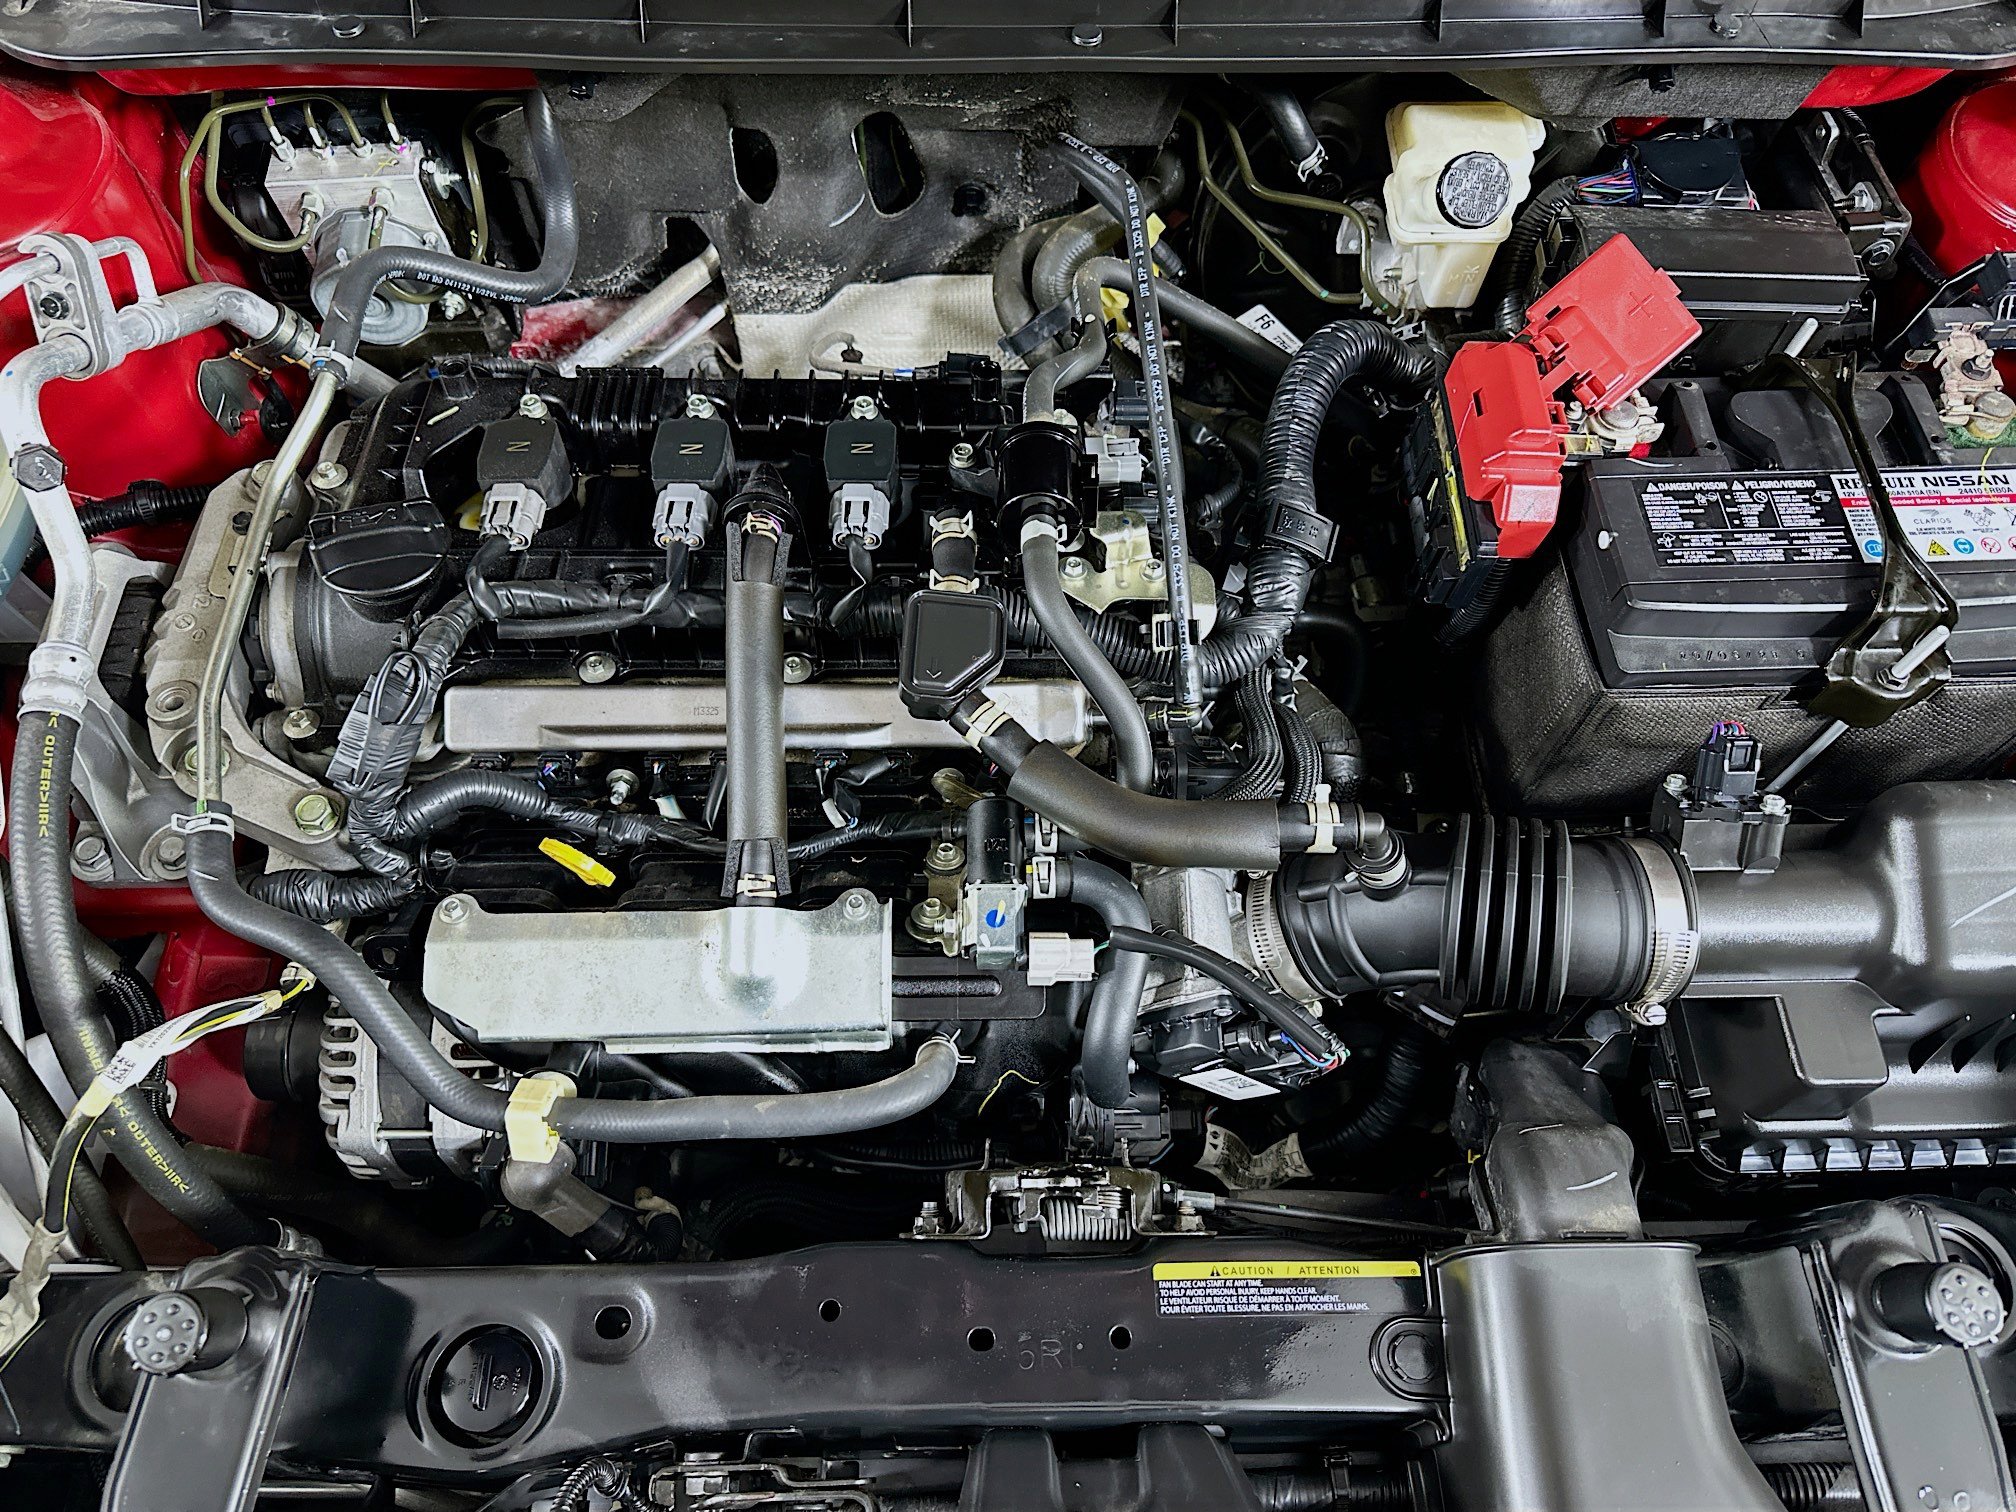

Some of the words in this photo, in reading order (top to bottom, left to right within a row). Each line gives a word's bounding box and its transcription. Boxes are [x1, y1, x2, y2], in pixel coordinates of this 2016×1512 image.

[1254, 313, 1276, 330] F6
[1143, 320, 1155, 341] KINK
[1744, 480, 1817, 490] PELIGRO/VENENO
[1923, 474, 2010, 487] NISSAN
[1657, 481, 1728, 492] DANGER/POISON
[1166, 495, 1178, 521] KINK
[1913, 517, 1952, 525] CLARIOS
[1171, 545, 1182, 560] DO
[1222, 1266, 1274, 1275] CAUTION
[1299, 1266, 1360, 1275] ATTENTION
[1159, 1281, 1172, 1289] FAN
[1172, 1280, 1193, 1288] BLADE
[1193, 1280, 1207, 1288] CAN
[1206, 1280, 1225, 1288] START
[1160, 1289, 1170, 1297] TO
[1185, 1288, 1206, 1296] AVOID
[1206, 1288, 1237, 1296] PERSONAL
[1260, 1287, 1275, 1295] KEEP
[1275, 1287, 1296, 1295] HANDS
[1297, 1286, 1317, 1294] CLEAR.
[1160, 1297, 1169, 1305] LE
[1169, 1297, 1213, 1305] VENTILATEUR
[1213, 1296, 1238, 1305] RISQUE
[1239, 1296, 1248, 1304] DE
[1249, 1294, 1285, 1304] DÉMARRER
[1285, 1294, 1291, 1302] À
[1291, 1295, 1309, 1303] TOUT
[1309, 1294, 1341, 1303] MOMENT.
[1160, 1306, 1180, 1314] POUR
[1180, 1304, 1204, 1314] ÉVITER
[1204, 1305, 1226, 1313] TOUTE
[1226, 1305, 1261, 1313] BLESSURE,
[1261, 1304, 1271, 1312] NE
[1271, 1304, 1284, 1312] PAS
[1295, 1303, 1333, 1311] APPROCHER
[1333, 1303, 1346, 1311] LES
[1346, 1302, 1370, 1311] MAINS.
